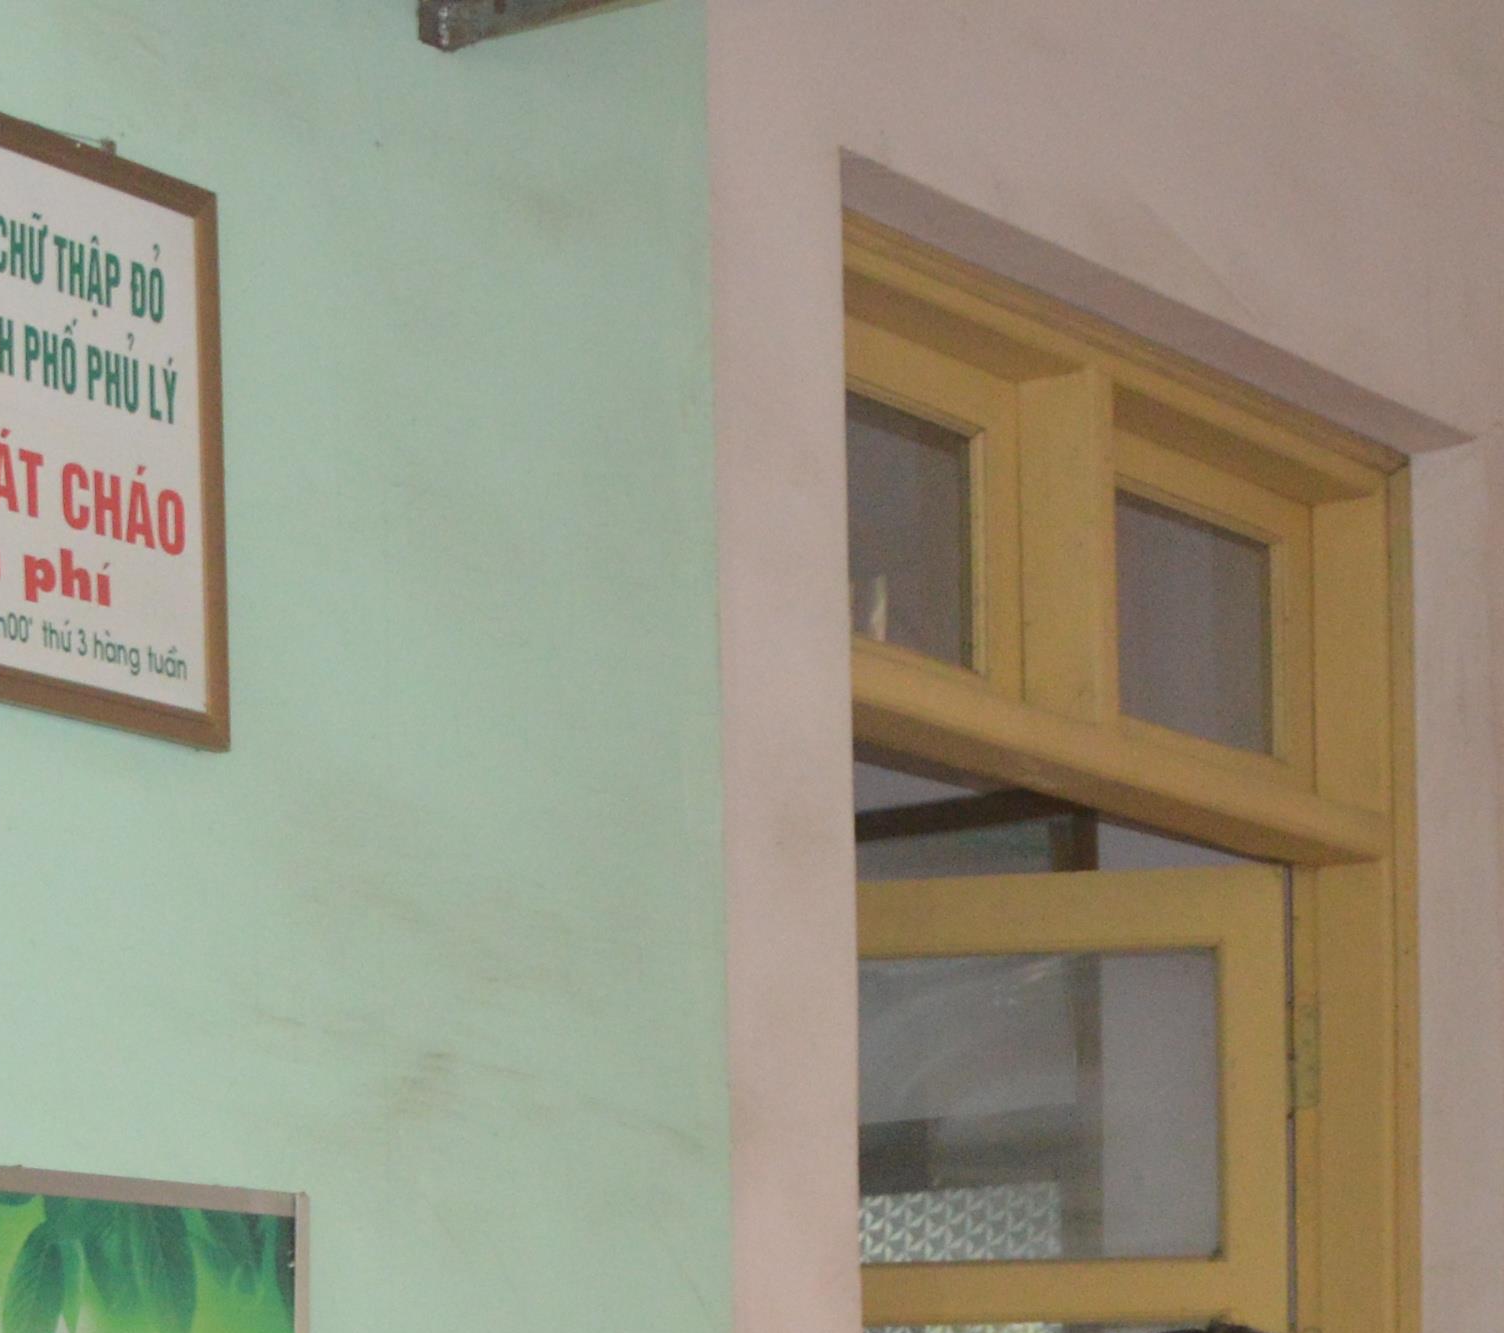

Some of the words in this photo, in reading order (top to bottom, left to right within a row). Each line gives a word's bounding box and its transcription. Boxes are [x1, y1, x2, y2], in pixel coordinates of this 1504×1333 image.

[53, 235, 121, 318] THẬP
[130, 243, 165, 324] ĐỎ
[24, 318, 78, 395] PHỐ
[87, 332, 140, 414] PHỦ
[149, 356, 178, 425] LÝ
[61, 462, 186, 556] CHÁO
[23, 547, 112, 607] phí
[42, 619, 72, 652] thứ
[78, 629, 87, 656] 3
[93, 630, 140, 676] hàng
[147, 645, 189, 680] tuần
